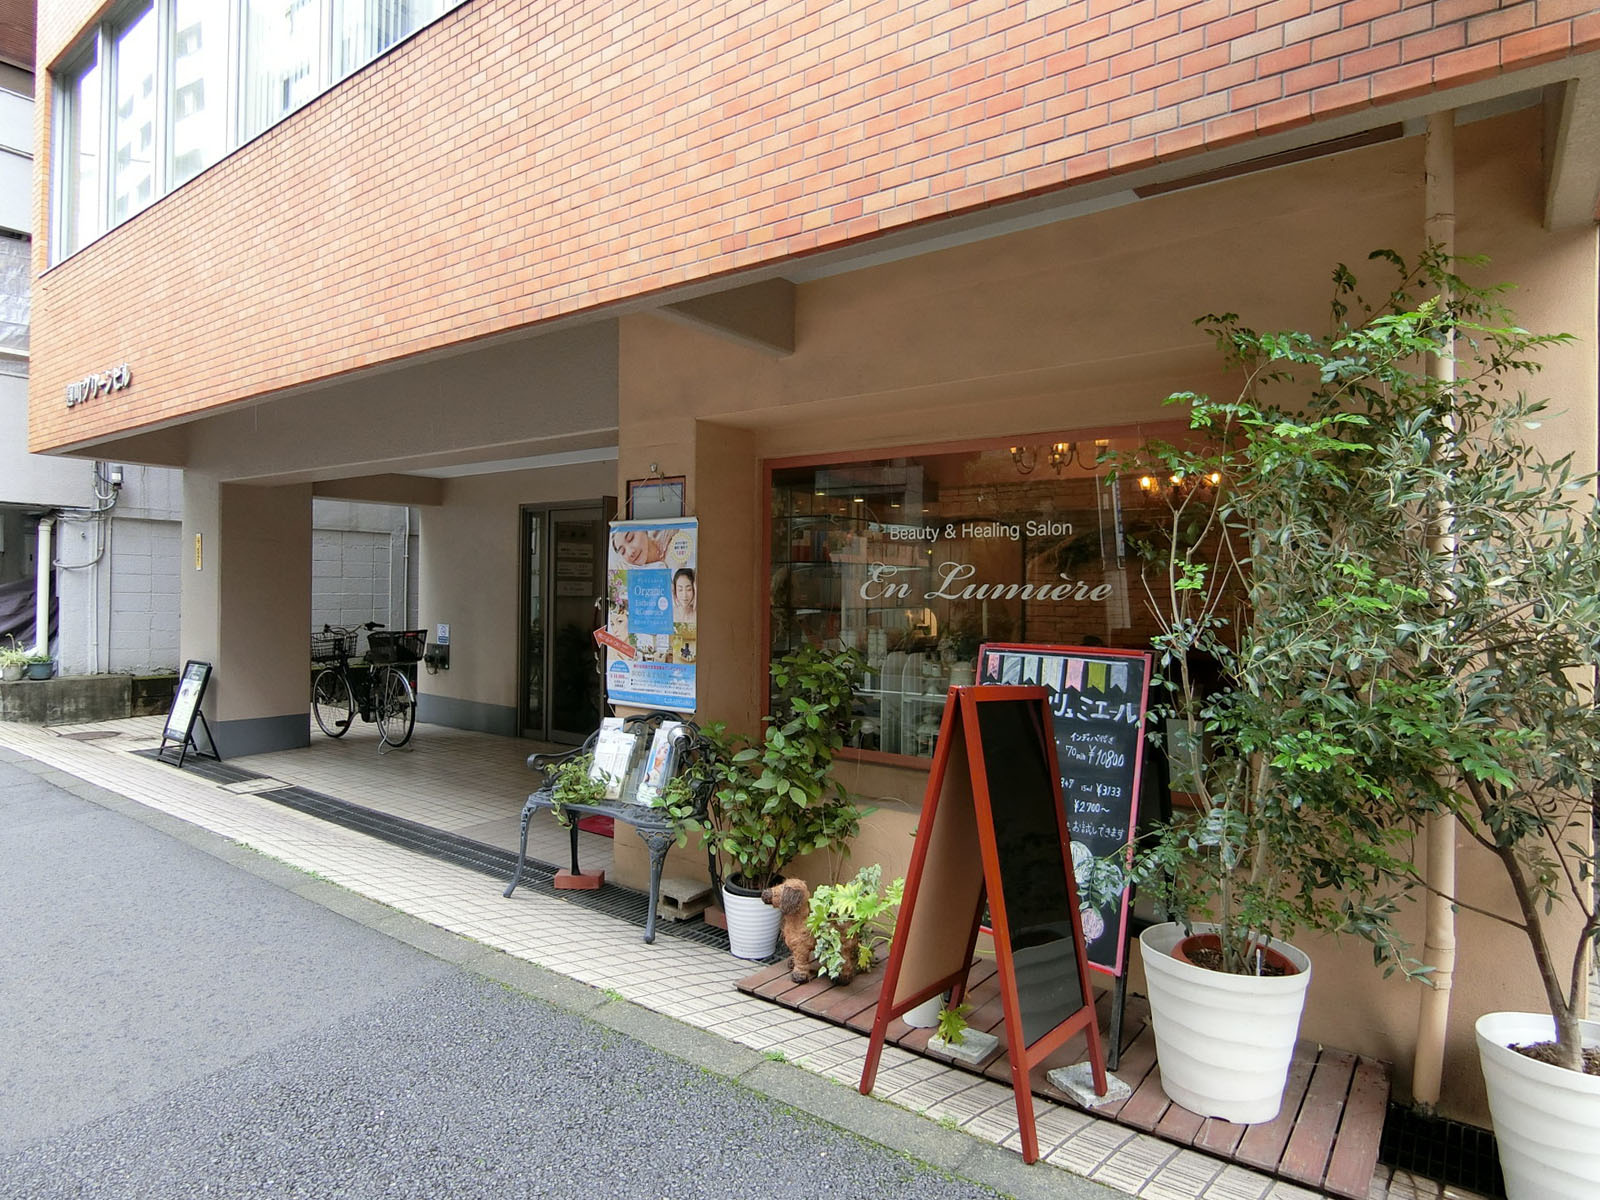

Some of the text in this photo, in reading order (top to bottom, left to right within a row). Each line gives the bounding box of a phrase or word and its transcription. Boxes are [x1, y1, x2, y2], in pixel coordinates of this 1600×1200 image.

[889, 520, 1073, 543] Beauty & Healing Salon
[634, 585, 665, 598] Organic
[859, 561, 1113, 602] En Lumière
[1048, 693, 1138, 724] リュミエール
[1088, 744, 1125, 769] ¥10800
[1095, 782, 1121, 798] ¥3133
